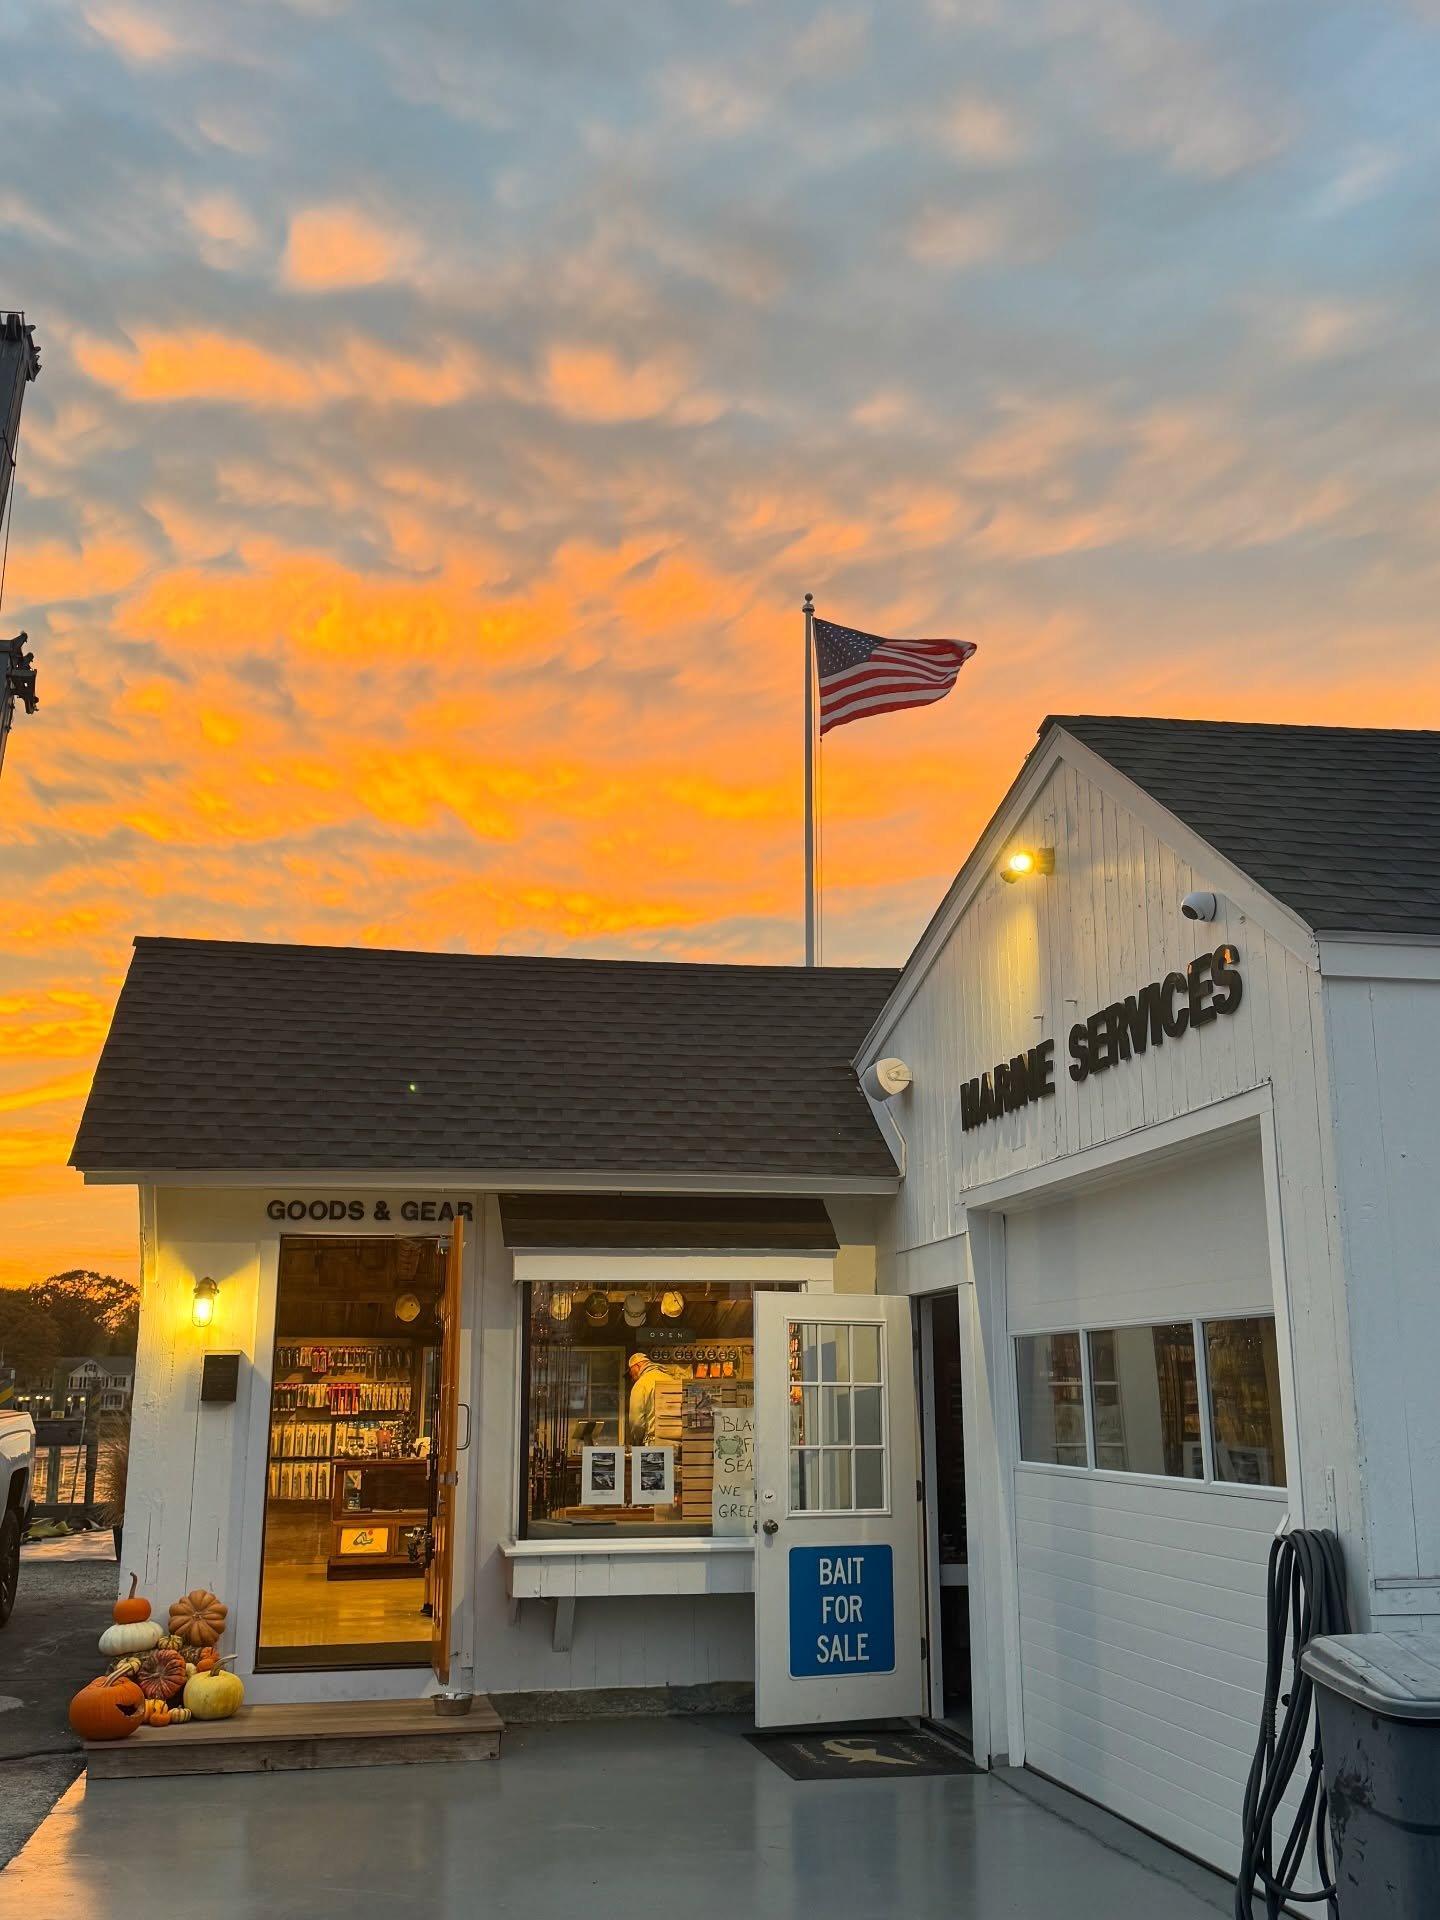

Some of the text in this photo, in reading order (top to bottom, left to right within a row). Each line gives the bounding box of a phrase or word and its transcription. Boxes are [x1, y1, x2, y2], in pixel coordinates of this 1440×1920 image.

[959, 943, 1244, 1132] MARINE SERVICES
[266, 1199, 474, 1222] GOODS & GEAR
[721, 1416, 755, 1432] BLA
[724, 1458, 753, 1473] SEA
[718, 1484, 741, 1497] WE
[718, 1503, 755, 1518] GREE
[819, 1557, 865, 1585] BAIT
[822, 1595, 863, 1624] FOR
[816, 1633, 870, 1664] SALE
